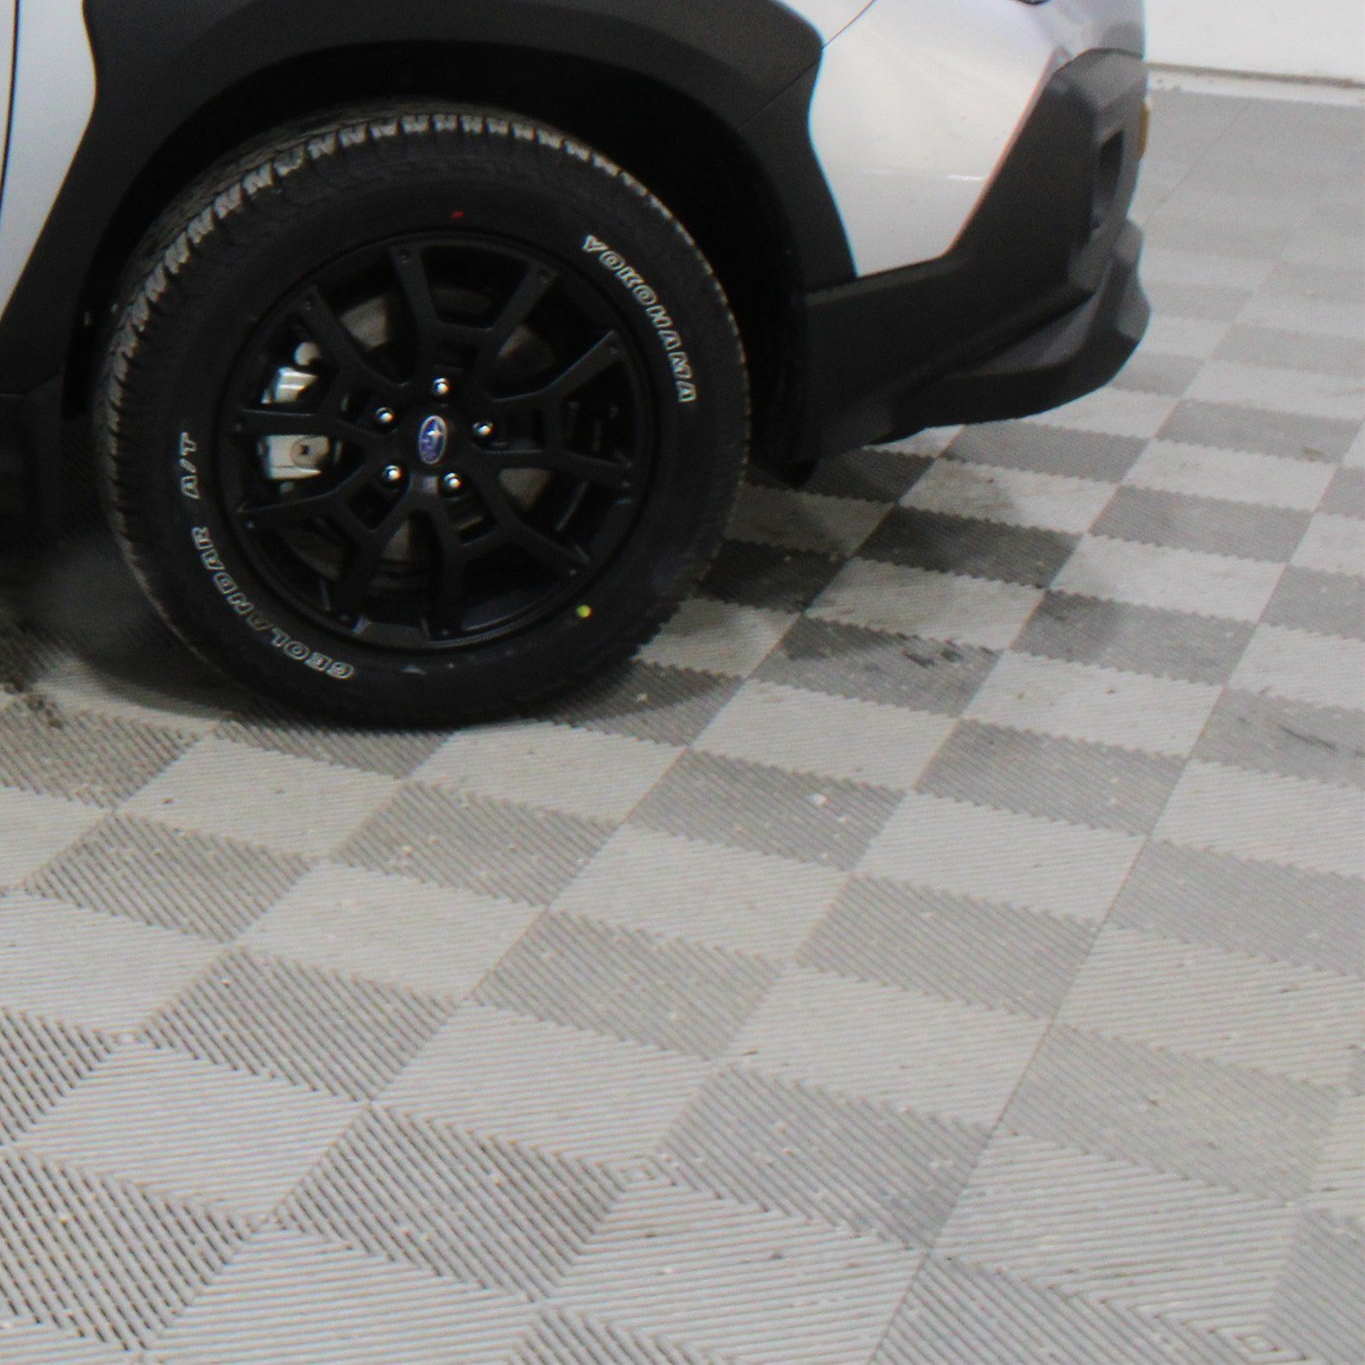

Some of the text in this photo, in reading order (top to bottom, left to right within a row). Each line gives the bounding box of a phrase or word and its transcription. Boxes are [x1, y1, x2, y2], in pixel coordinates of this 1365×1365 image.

[581, 234, 698, 404] YOKOHAMA
[178, 431, 355, 680] GEOLANDAR A/T
